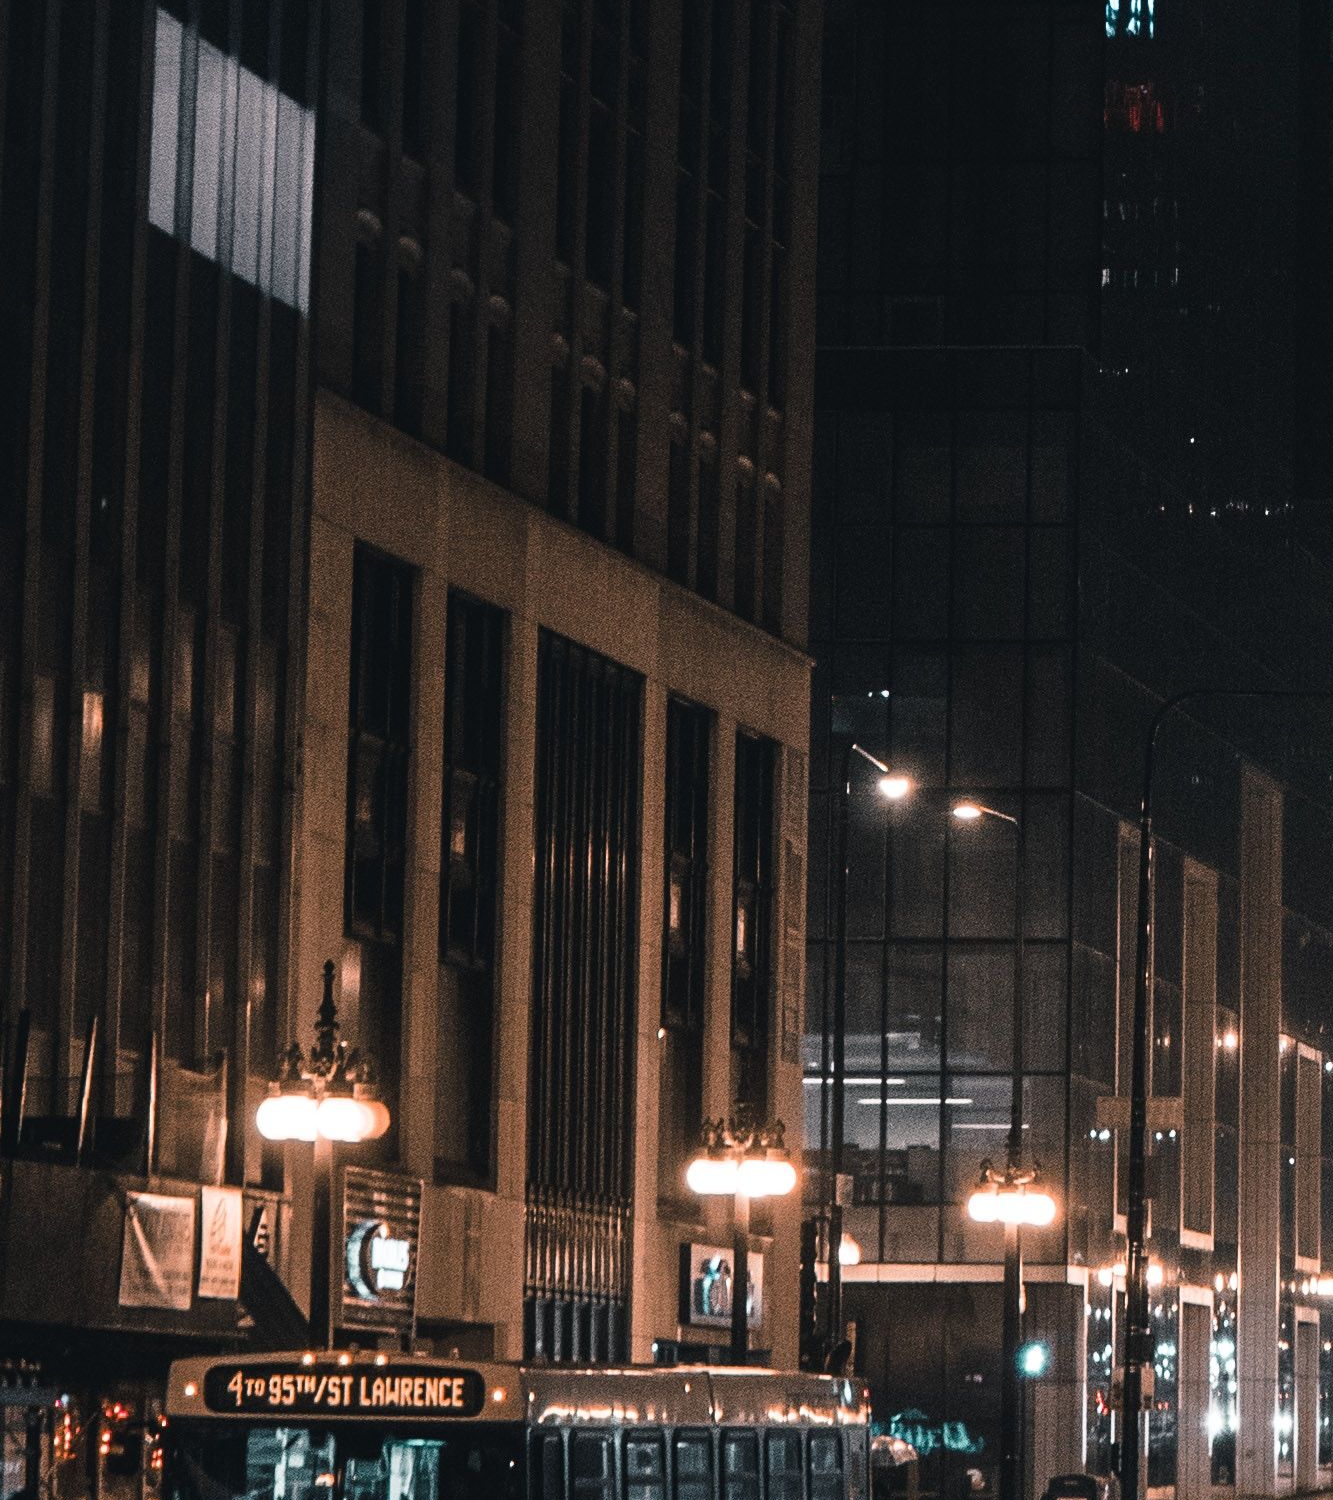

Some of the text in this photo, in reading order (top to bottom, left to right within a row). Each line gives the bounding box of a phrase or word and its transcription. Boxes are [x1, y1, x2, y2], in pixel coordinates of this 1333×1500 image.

[227, 1370, 243, 1407] 4
[245, 1378, 266, 1397] TO
[359, 1376, 466, 1408] LAWRENCE
